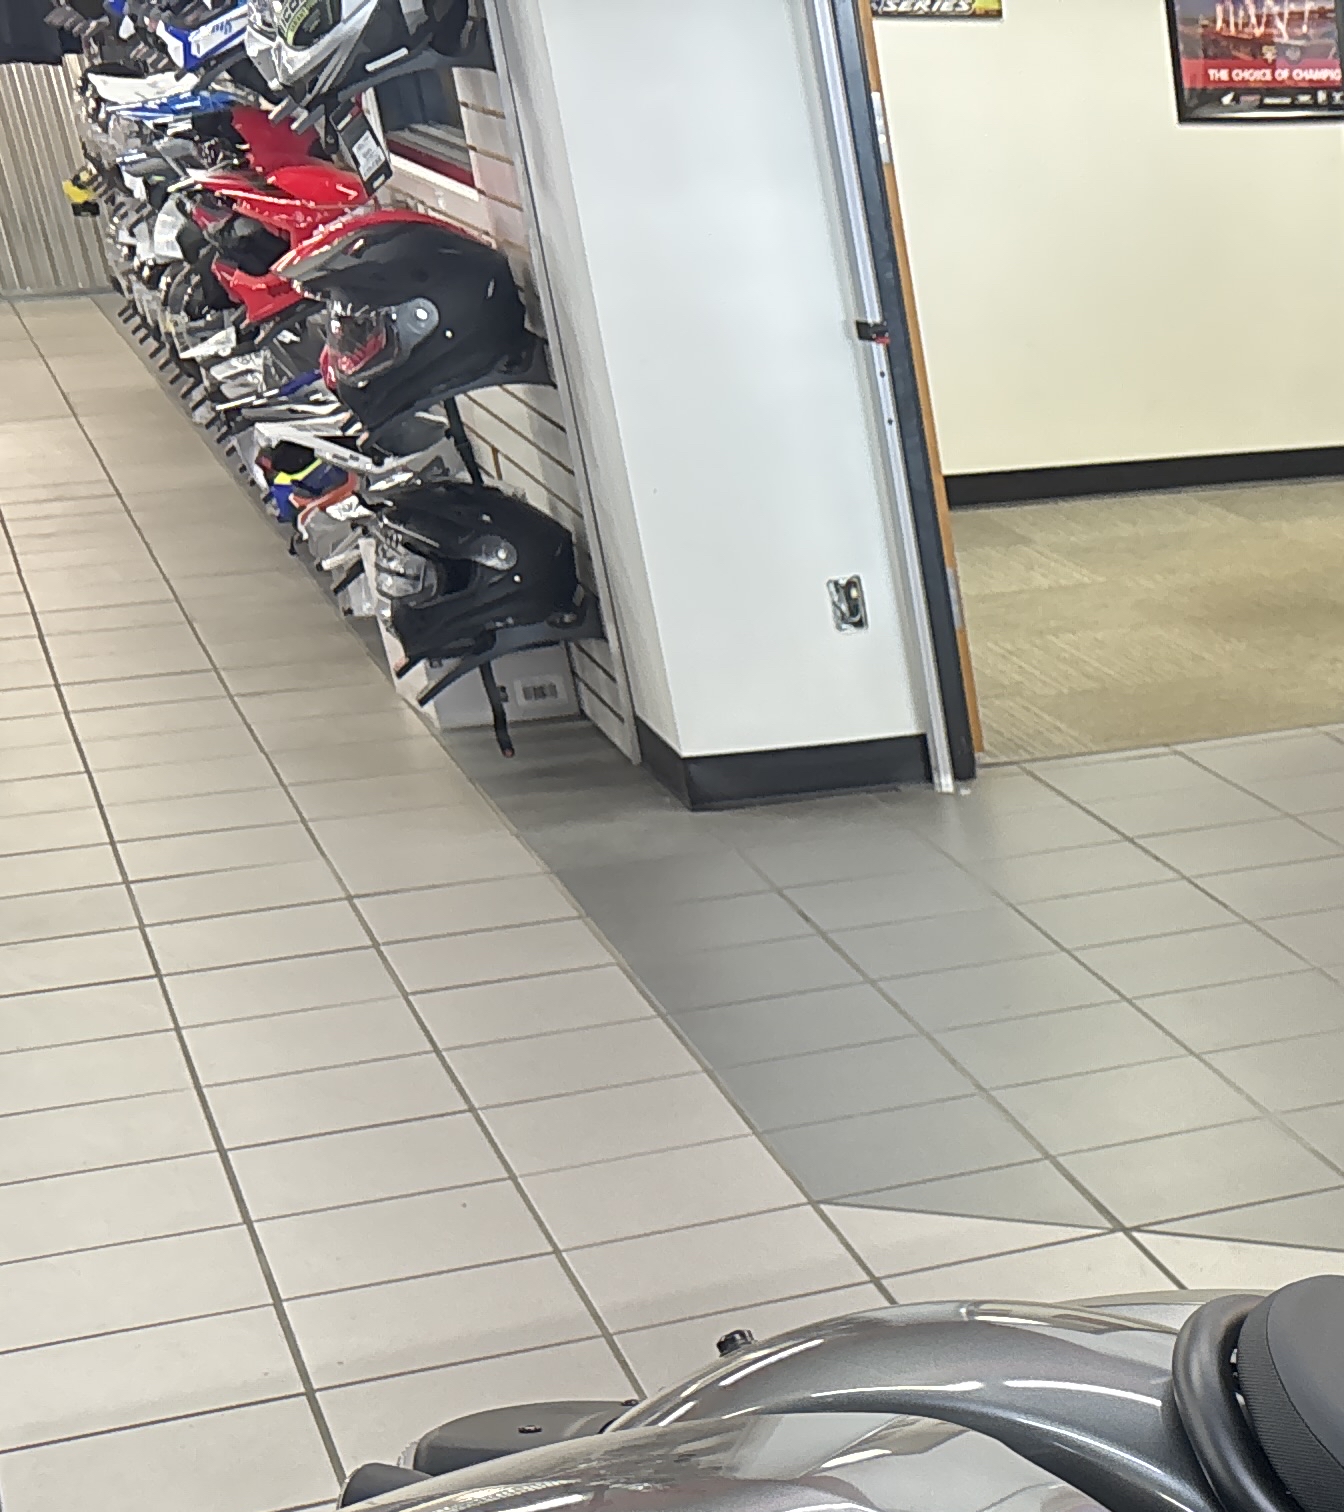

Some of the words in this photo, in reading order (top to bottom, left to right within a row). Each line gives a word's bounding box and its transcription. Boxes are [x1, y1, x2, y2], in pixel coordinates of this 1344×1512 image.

[1208, 69, 1229, 81] THE
[1231, 69, 1273, 81] CHOICE
[1274, 69, 1290, 81] OF
